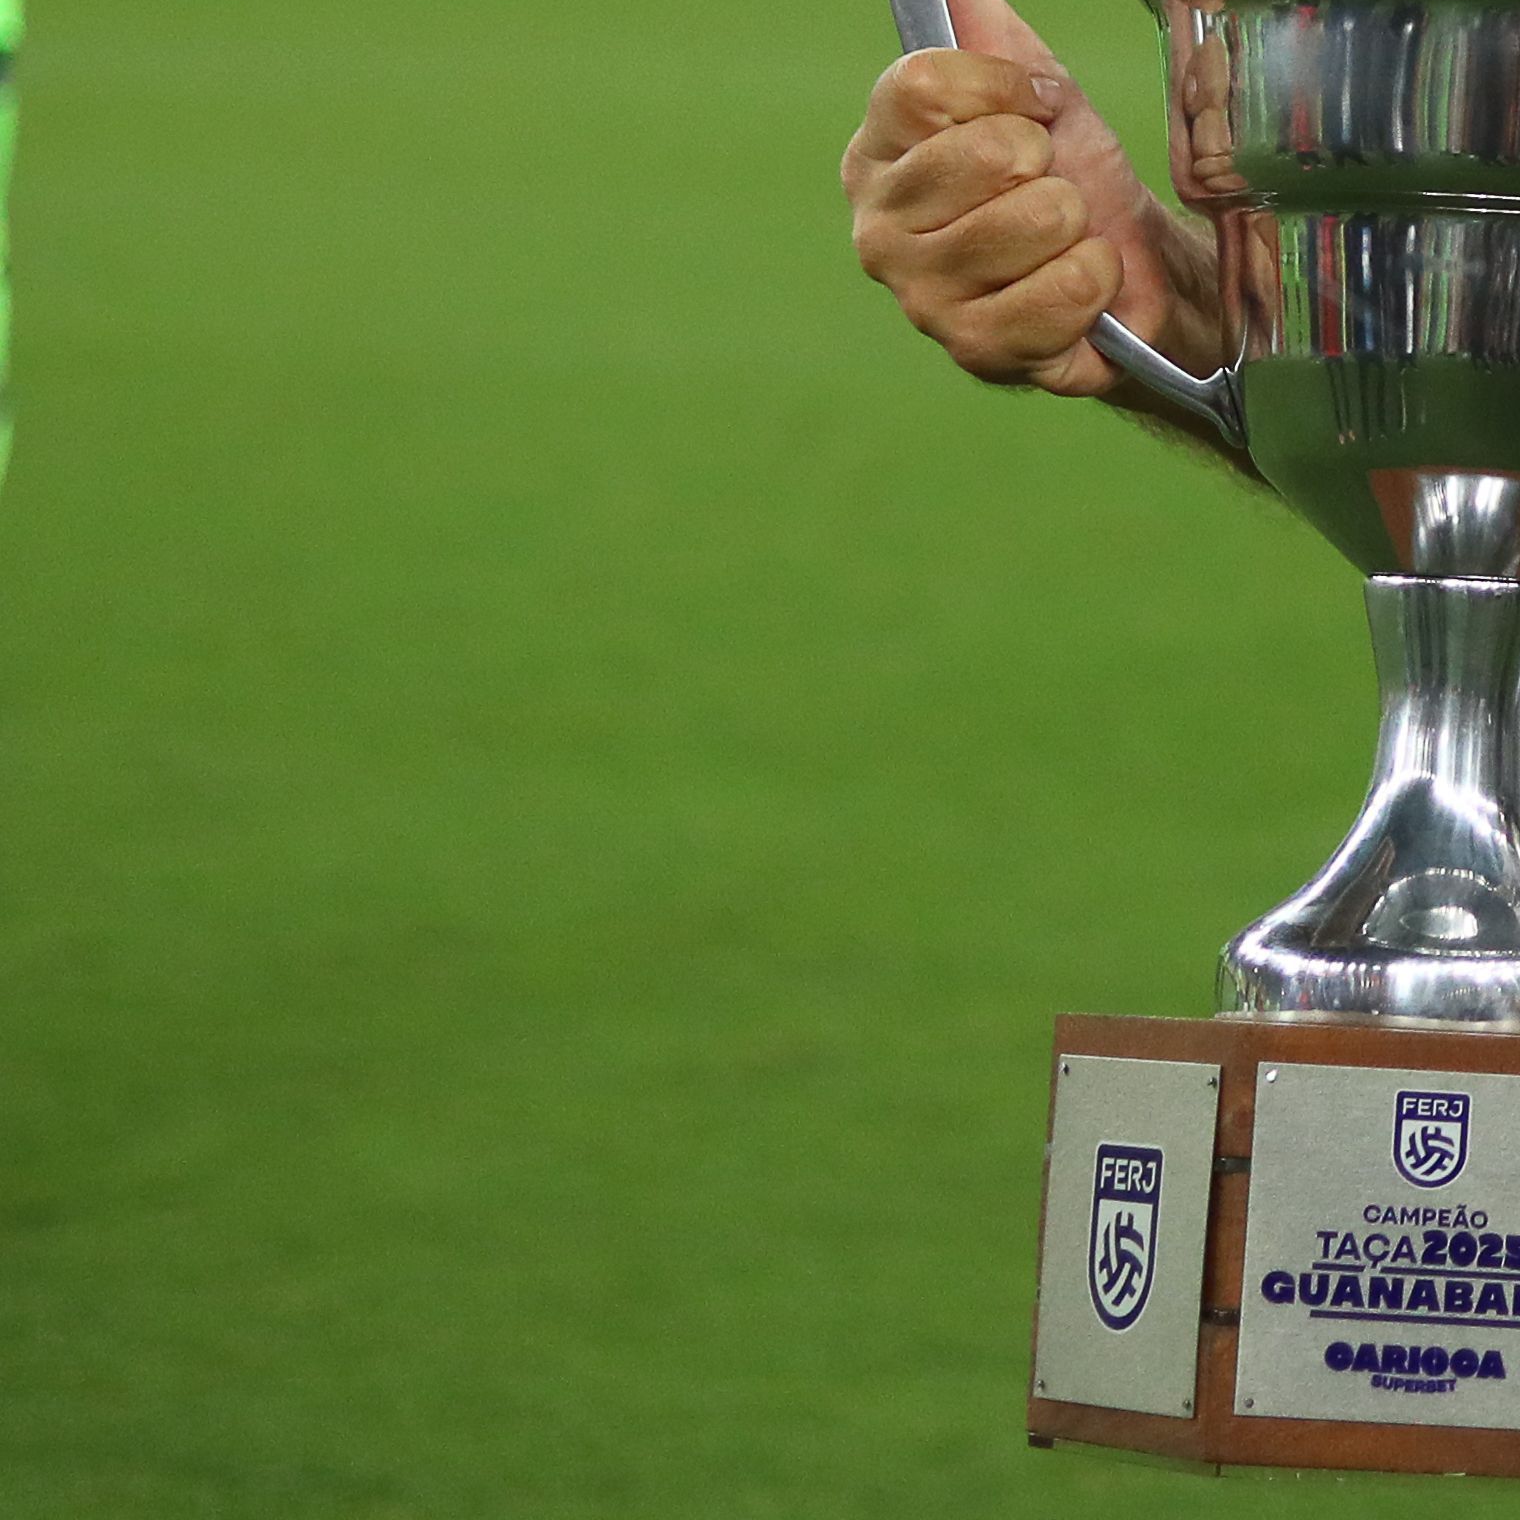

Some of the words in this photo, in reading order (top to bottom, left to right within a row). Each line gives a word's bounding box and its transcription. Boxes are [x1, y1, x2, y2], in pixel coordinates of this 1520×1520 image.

[1403, 1097, 1463, 1118] FERJ
[1100, 1157, 1157, 1194] FERJ
[1363, 1204, 1488, 1229] CAMPEÃO
[1316, 1231, 1417, 1269] TAÇA
[1324, 1341, 1506, 1379] CARIOCA
[1370, 1374, 1458, 1394] SUPERBET
